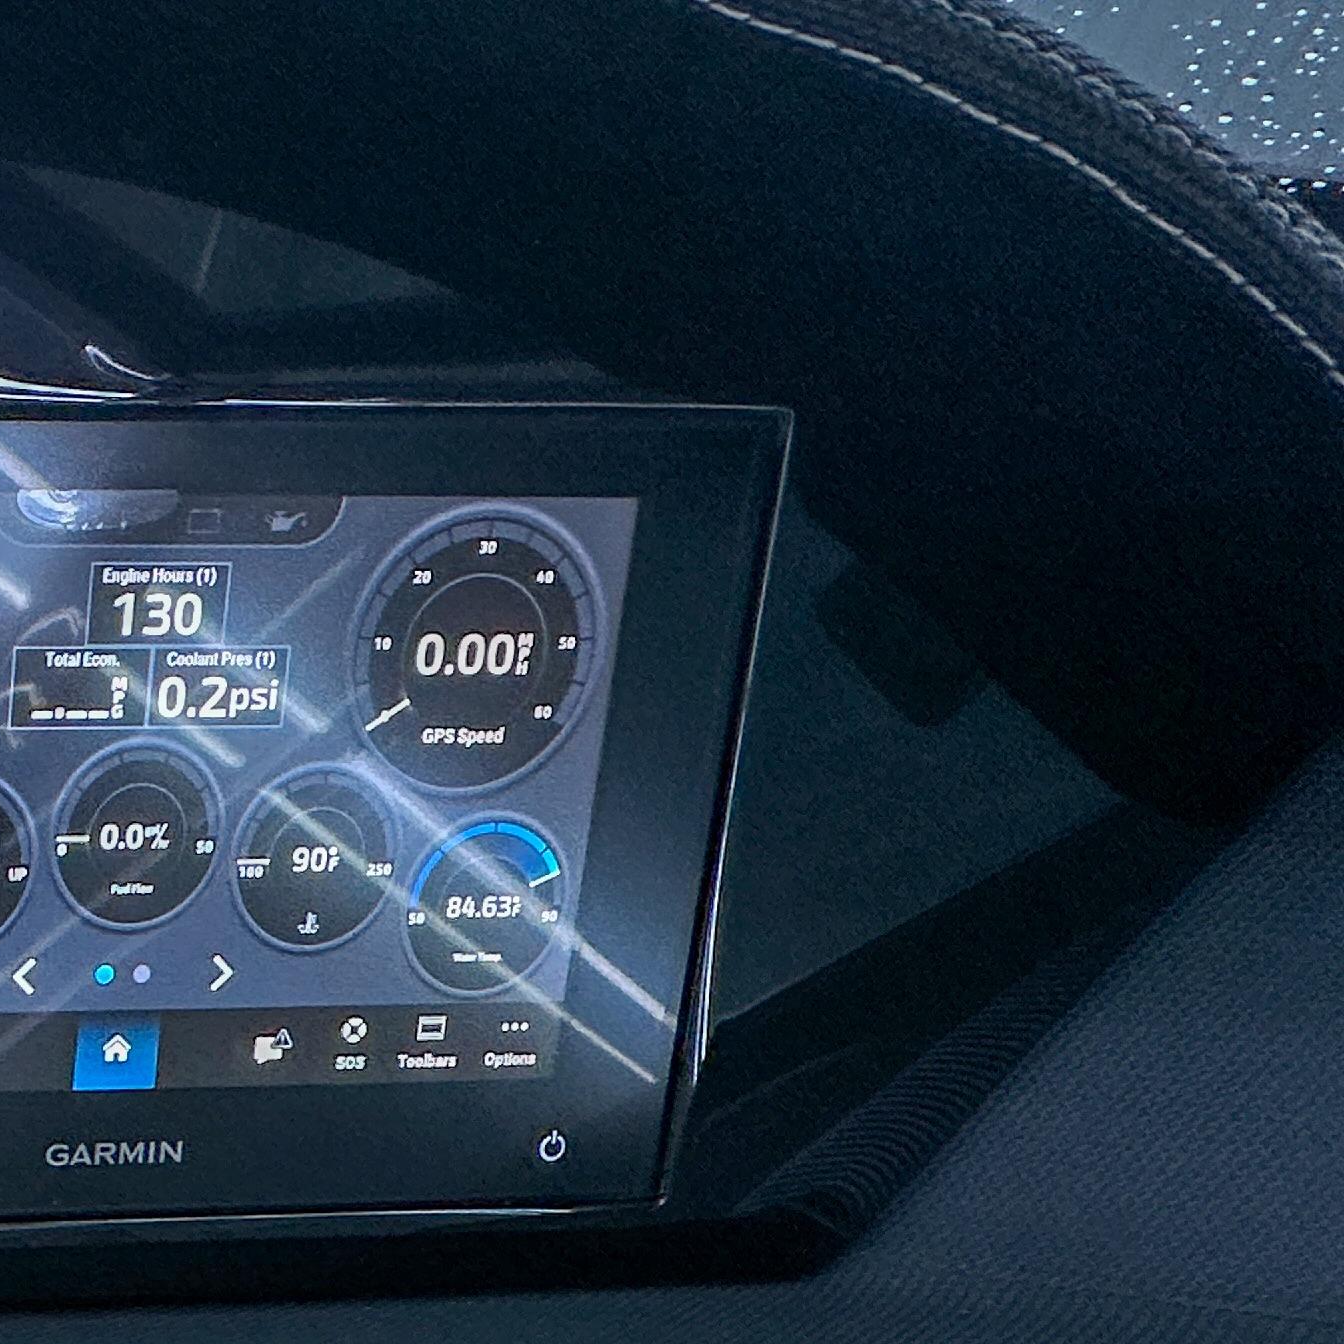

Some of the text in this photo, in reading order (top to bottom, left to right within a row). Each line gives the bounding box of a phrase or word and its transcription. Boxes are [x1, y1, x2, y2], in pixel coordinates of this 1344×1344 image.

[478, 540, 498, 555] 30
[102, 567, 218, 587] Engine Hours (1)
[412, 570, 432, 585] 20
[535, 570, 555, 585] 40
[112, 592, 203, 637] 130
[374, 636, 393, 651] 10
[558, 636, 577, 651] 50
[45, 652, 121, 668] Total Econ.
[166, 650, 276, 669] Coolant Pres (1)
[416, 632, 514, 677] 0.00
[533, 705, 553, 720] 60
[421, 726, 506, 748] GPS Speed
[99, 823, 171, 851] 0.0%
[8, 866, 28, 882] UP
[366, 862, 394, 877] 250
[334, 1054, 367, 1071] SOS
[397, 1052, 458, 1070] Toolbars
[483, 1050, 538, 1069] Options
[44, 1140, 184, 1167] GARMIN
